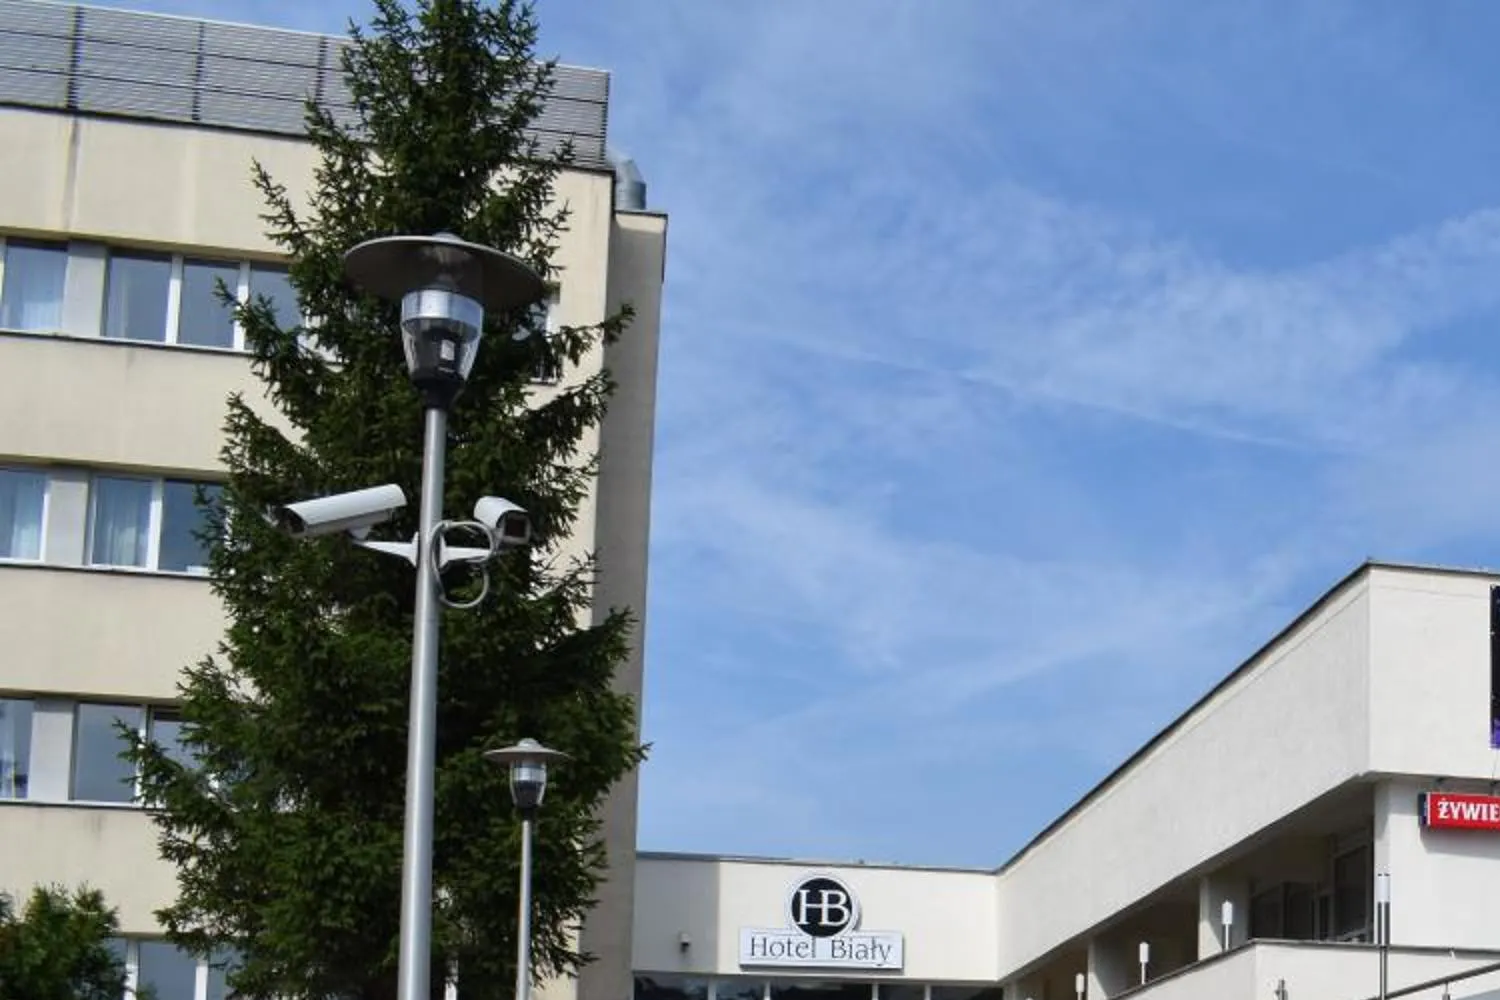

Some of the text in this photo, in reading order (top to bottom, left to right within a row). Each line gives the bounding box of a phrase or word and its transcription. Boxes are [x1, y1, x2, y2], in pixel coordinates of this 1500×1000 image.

[797, 888, 851, 927] HB
[750, 936, 893, 966] Hotel Biały
